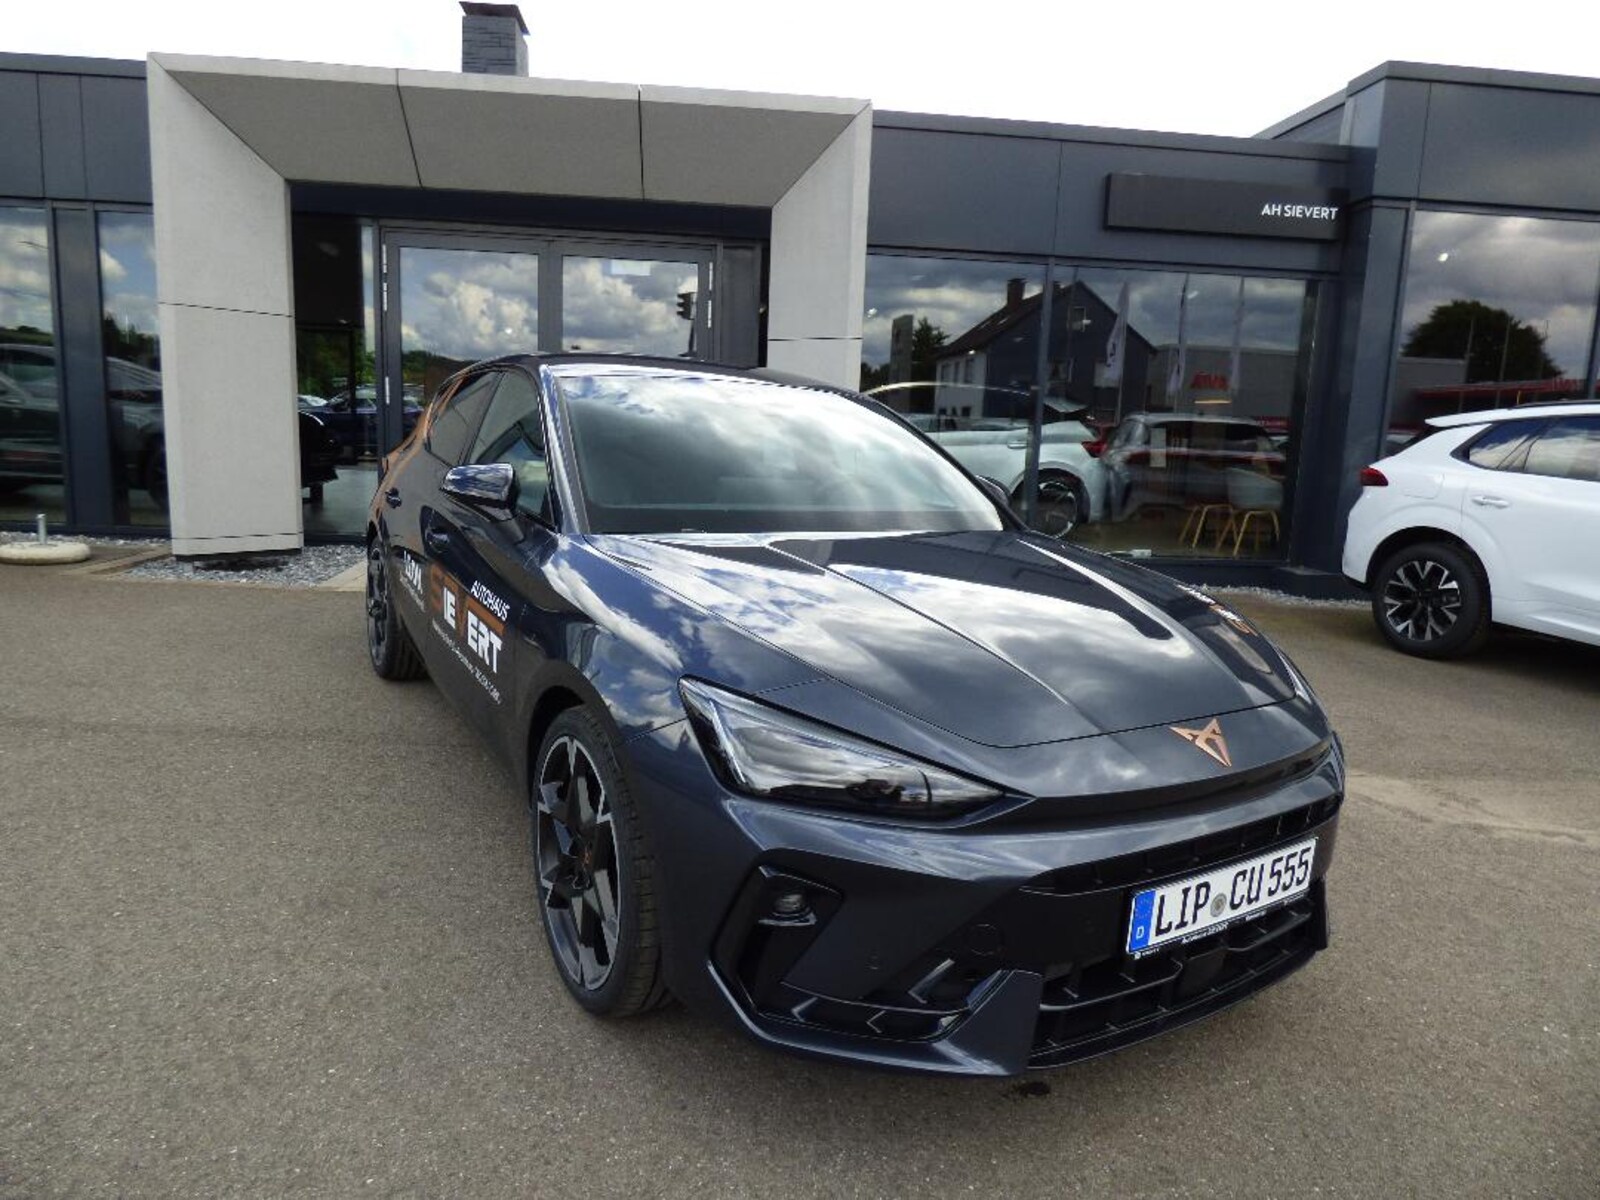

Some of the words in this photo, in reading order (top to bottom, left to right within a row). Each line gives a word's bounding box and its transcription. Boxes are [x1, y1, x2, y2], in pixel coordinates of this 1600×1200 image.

[1261, 204, 1281, 217] AH
[1283, 205, 1338, 220] SIEVERT
[1155, 880, 1211, 936] LIP
[1229, 863, 1265, 911] CU
[1267, 846, 1312, 897] 555
[1136, 925, 1144, 940] D
